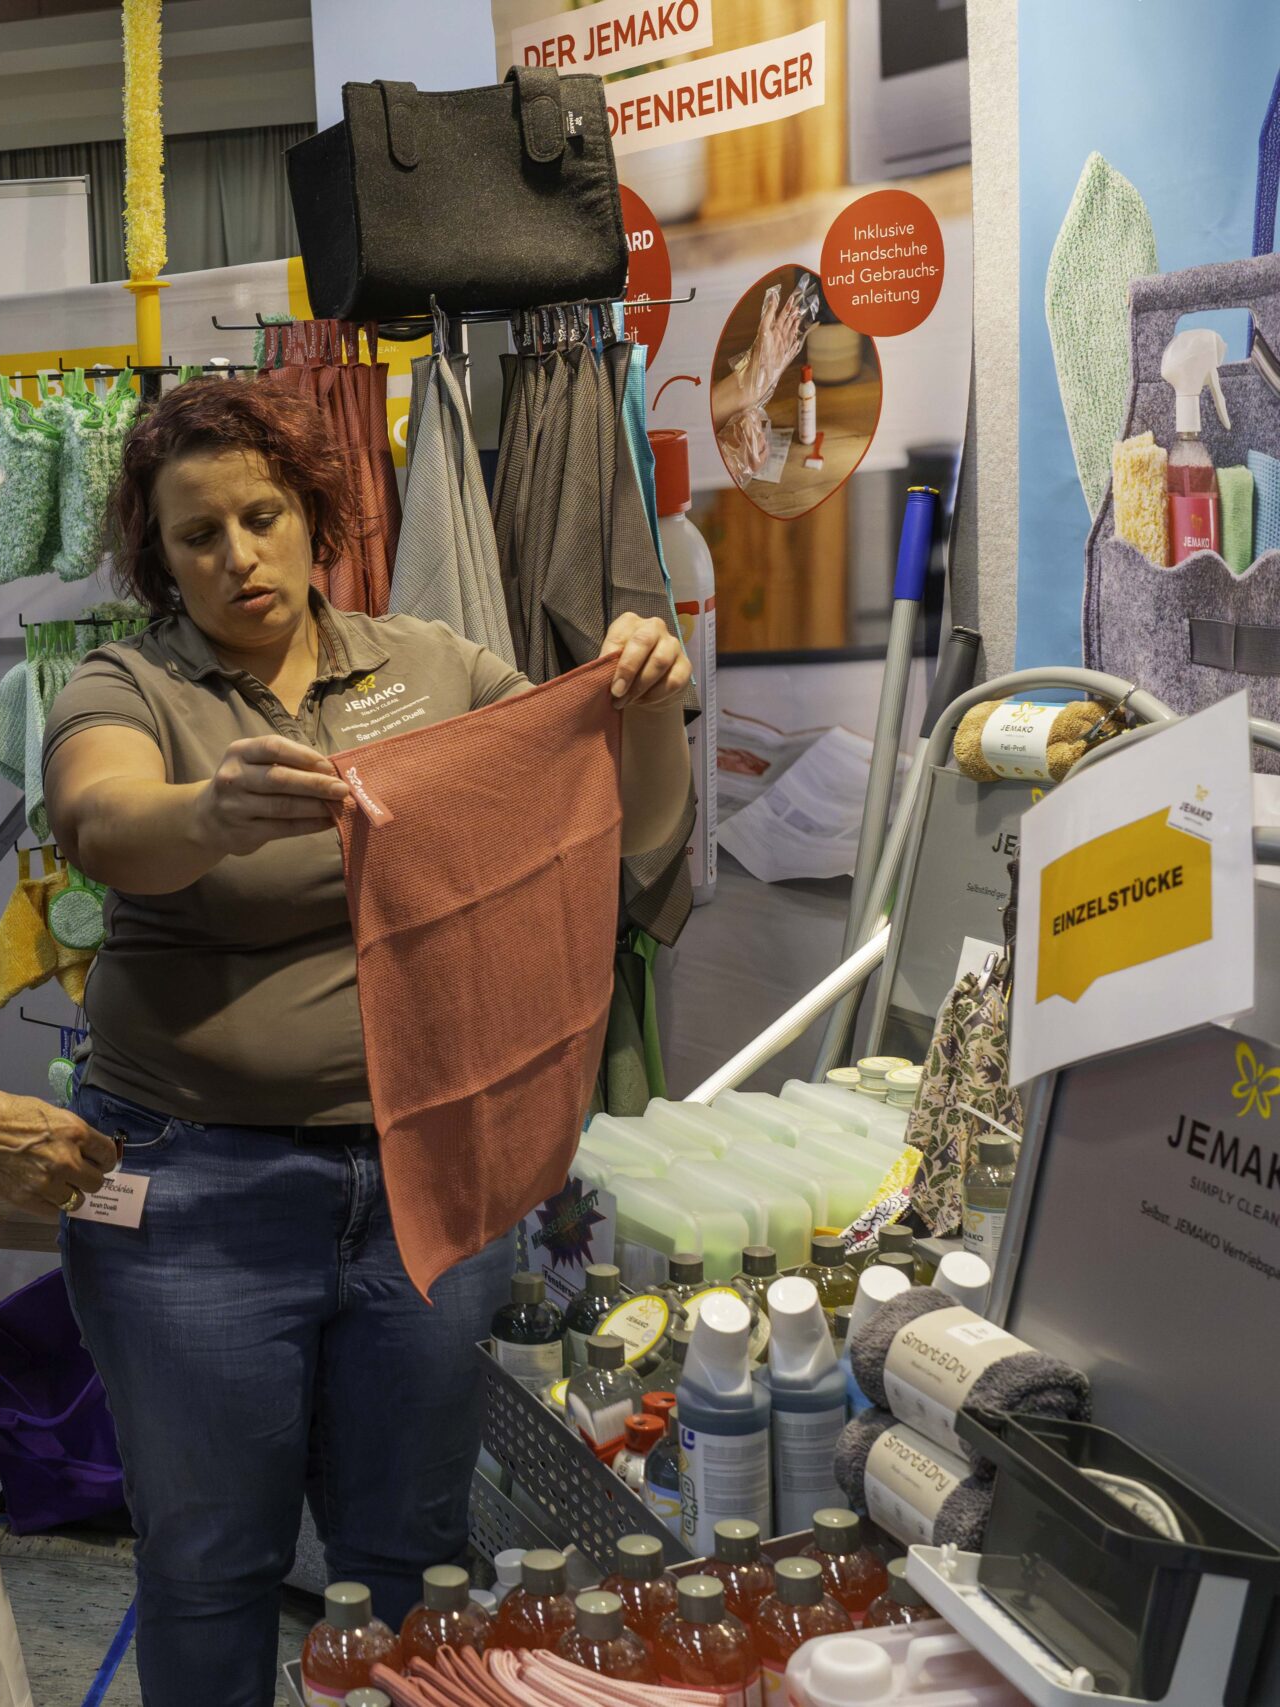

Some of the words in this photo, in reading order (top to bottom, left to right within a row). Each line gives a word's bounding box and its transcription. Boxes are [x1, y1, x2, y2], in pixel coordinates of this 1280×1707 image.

[523, 34, 577, 68] DER
[584, 0, 700, 61] JEMAKO
[854, 222, 915, 240] Inklusive
[840, 241, 928, 264] Handschuhe
[827, 269, 855, 286] und
[859, 262, 940, 283] Gebrauchs-
[851, 289, 920, 306] anleitung
[1183, 536, 1210, 548] JEMAKO
[344, 682, 406, 713] JEMAKO
[356, 729, 381, 742] Sarah
[381, 719, 402, 733] Jane
[1000, 724, 1034, 734] JEMAKO
[355, 785, 384, 816] JEMAKO
[1052, 865, 1185, 937] EINZELSTÜCKE
[1190, 1175, 1236, 1206] SIMPLY
[1174, 1217, 1220, 1249] JEMAKO
